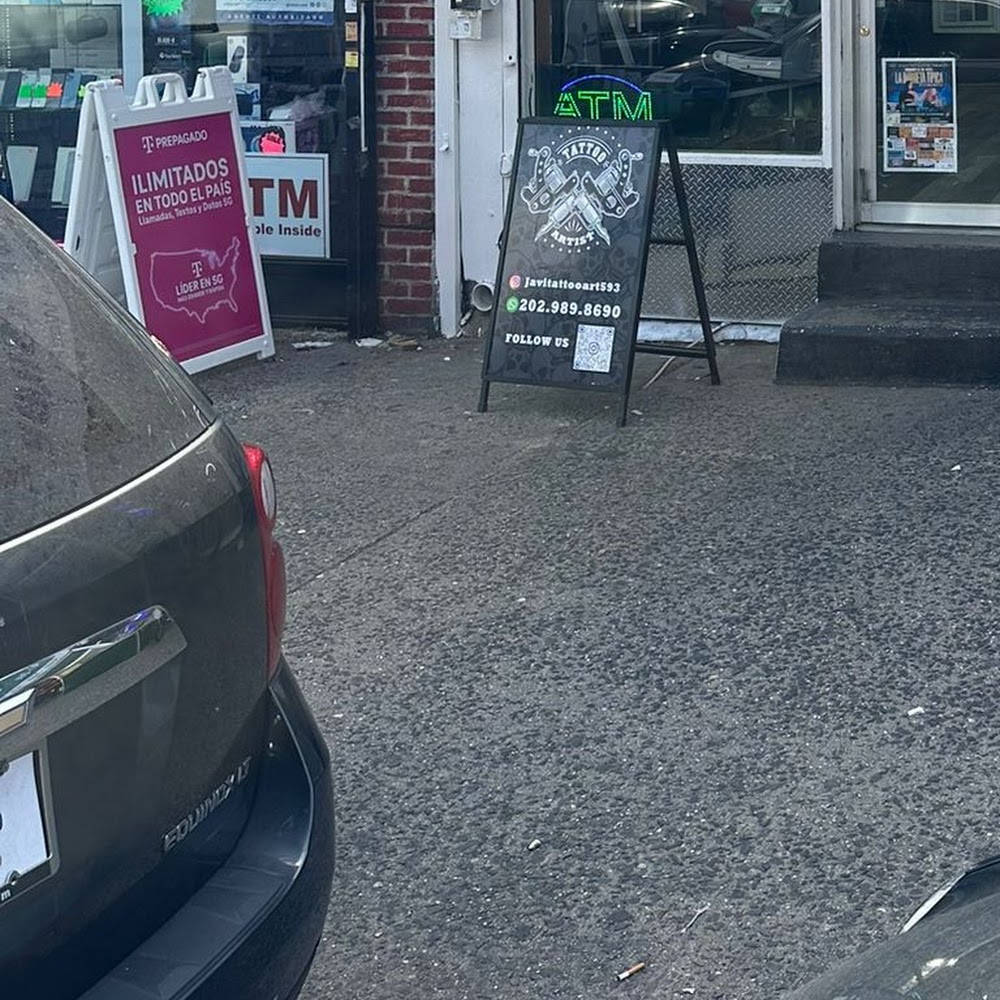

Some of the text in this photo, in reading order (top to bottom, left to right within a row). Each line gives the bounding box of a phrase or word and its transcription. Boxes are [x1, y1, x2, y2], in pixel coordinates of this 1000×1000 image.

[554, 90, 653, 120] ATM
[155, 129, 208, 149] PREPAGADO
[562, 142, 607, 163] TATTOO
[131, 157, 229, 195] ILIMITADOS
[135, 178, 232, 214] EN TODO EL PAÍS
[248, 177, 319, 219] TM
[174, 205, 197, 217] Textos
[203, 200, 222, 211] Datos
[278, 223, 322, 237] Inside
[551, 229, 595, 246] ARTIST
[175, 280, 200, 296] LÍDER
[200, 277, 211, 289] EN
[519, 298, 621, 318] 202.989.8690
[505, 333, 570, 348] FOLLOW US
